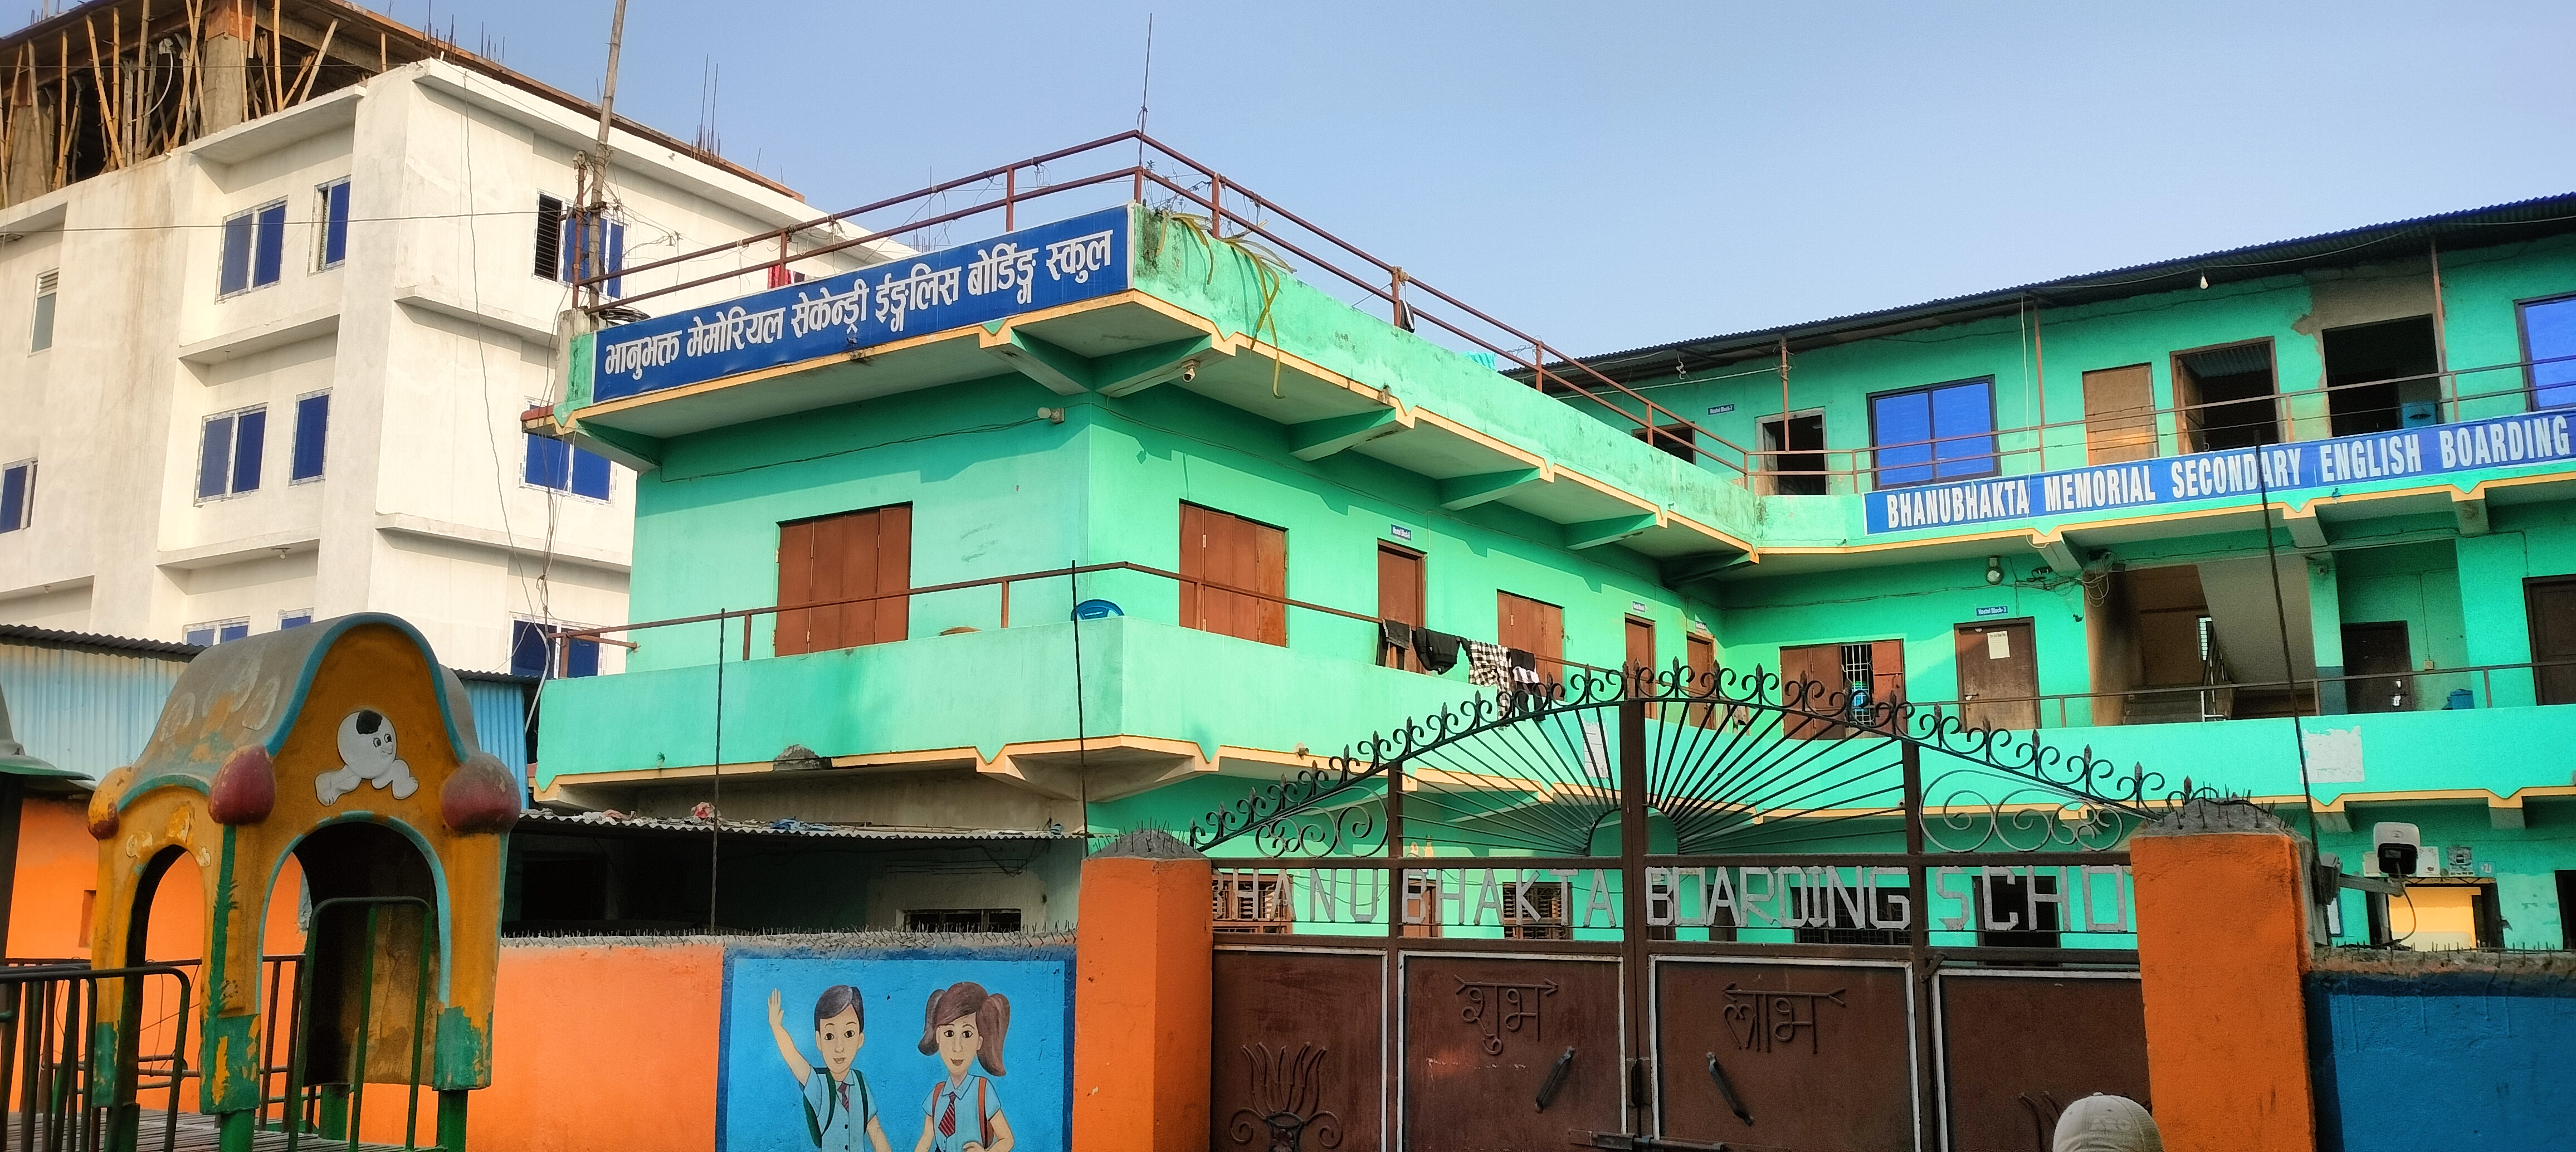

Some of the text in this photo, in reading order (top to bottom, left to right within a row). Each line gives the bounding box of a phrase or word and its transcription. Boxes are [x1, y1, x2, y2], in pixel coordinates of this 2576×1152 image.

[604, 330, 682, 380] भानुभक्त
[686, 305, 787, 357] मेमोरियल
[791, 278, 870, 338] सेकेन्ड्री
[1886, 415, 2570, 529] BHANUBHAKTA MEMORIAL SECONDARY ENGLISH BOARDING
[1645, 866, 1910, 929] BOARDING
[1456, 977, 1558, 1055] शुभ
[1722, 983, 1840, 1054] लाभ
